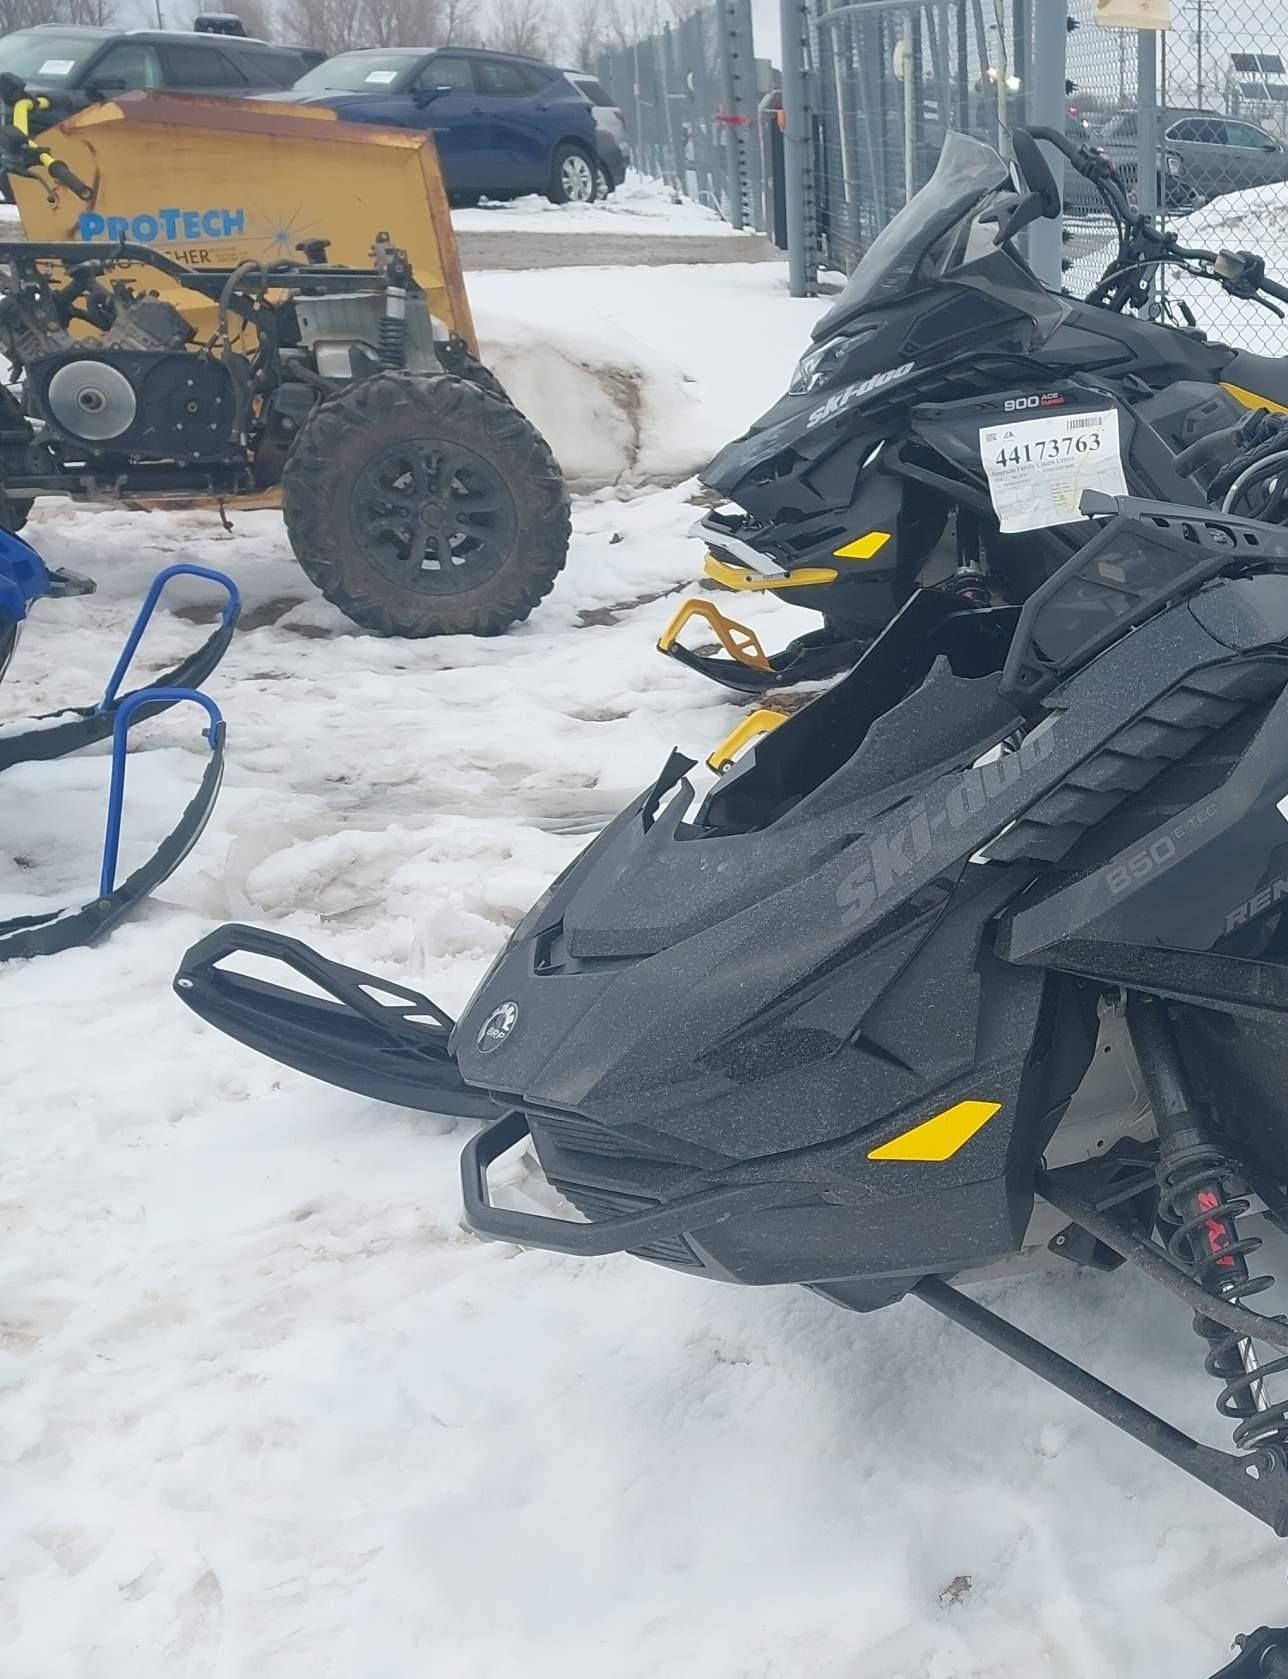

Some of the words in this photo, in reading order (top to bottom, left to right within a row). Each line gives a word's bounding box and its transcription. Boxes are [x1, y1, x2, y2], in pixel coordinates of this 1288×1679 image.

[1003, 396, 1039, 412] 900
[995, 433, 1101, 467] 44173763
[1105, 836, 1175, 894] 850
[1174, 804, 1217, 838] E-TEC
[486, 1026, 505, 1039] BRP
